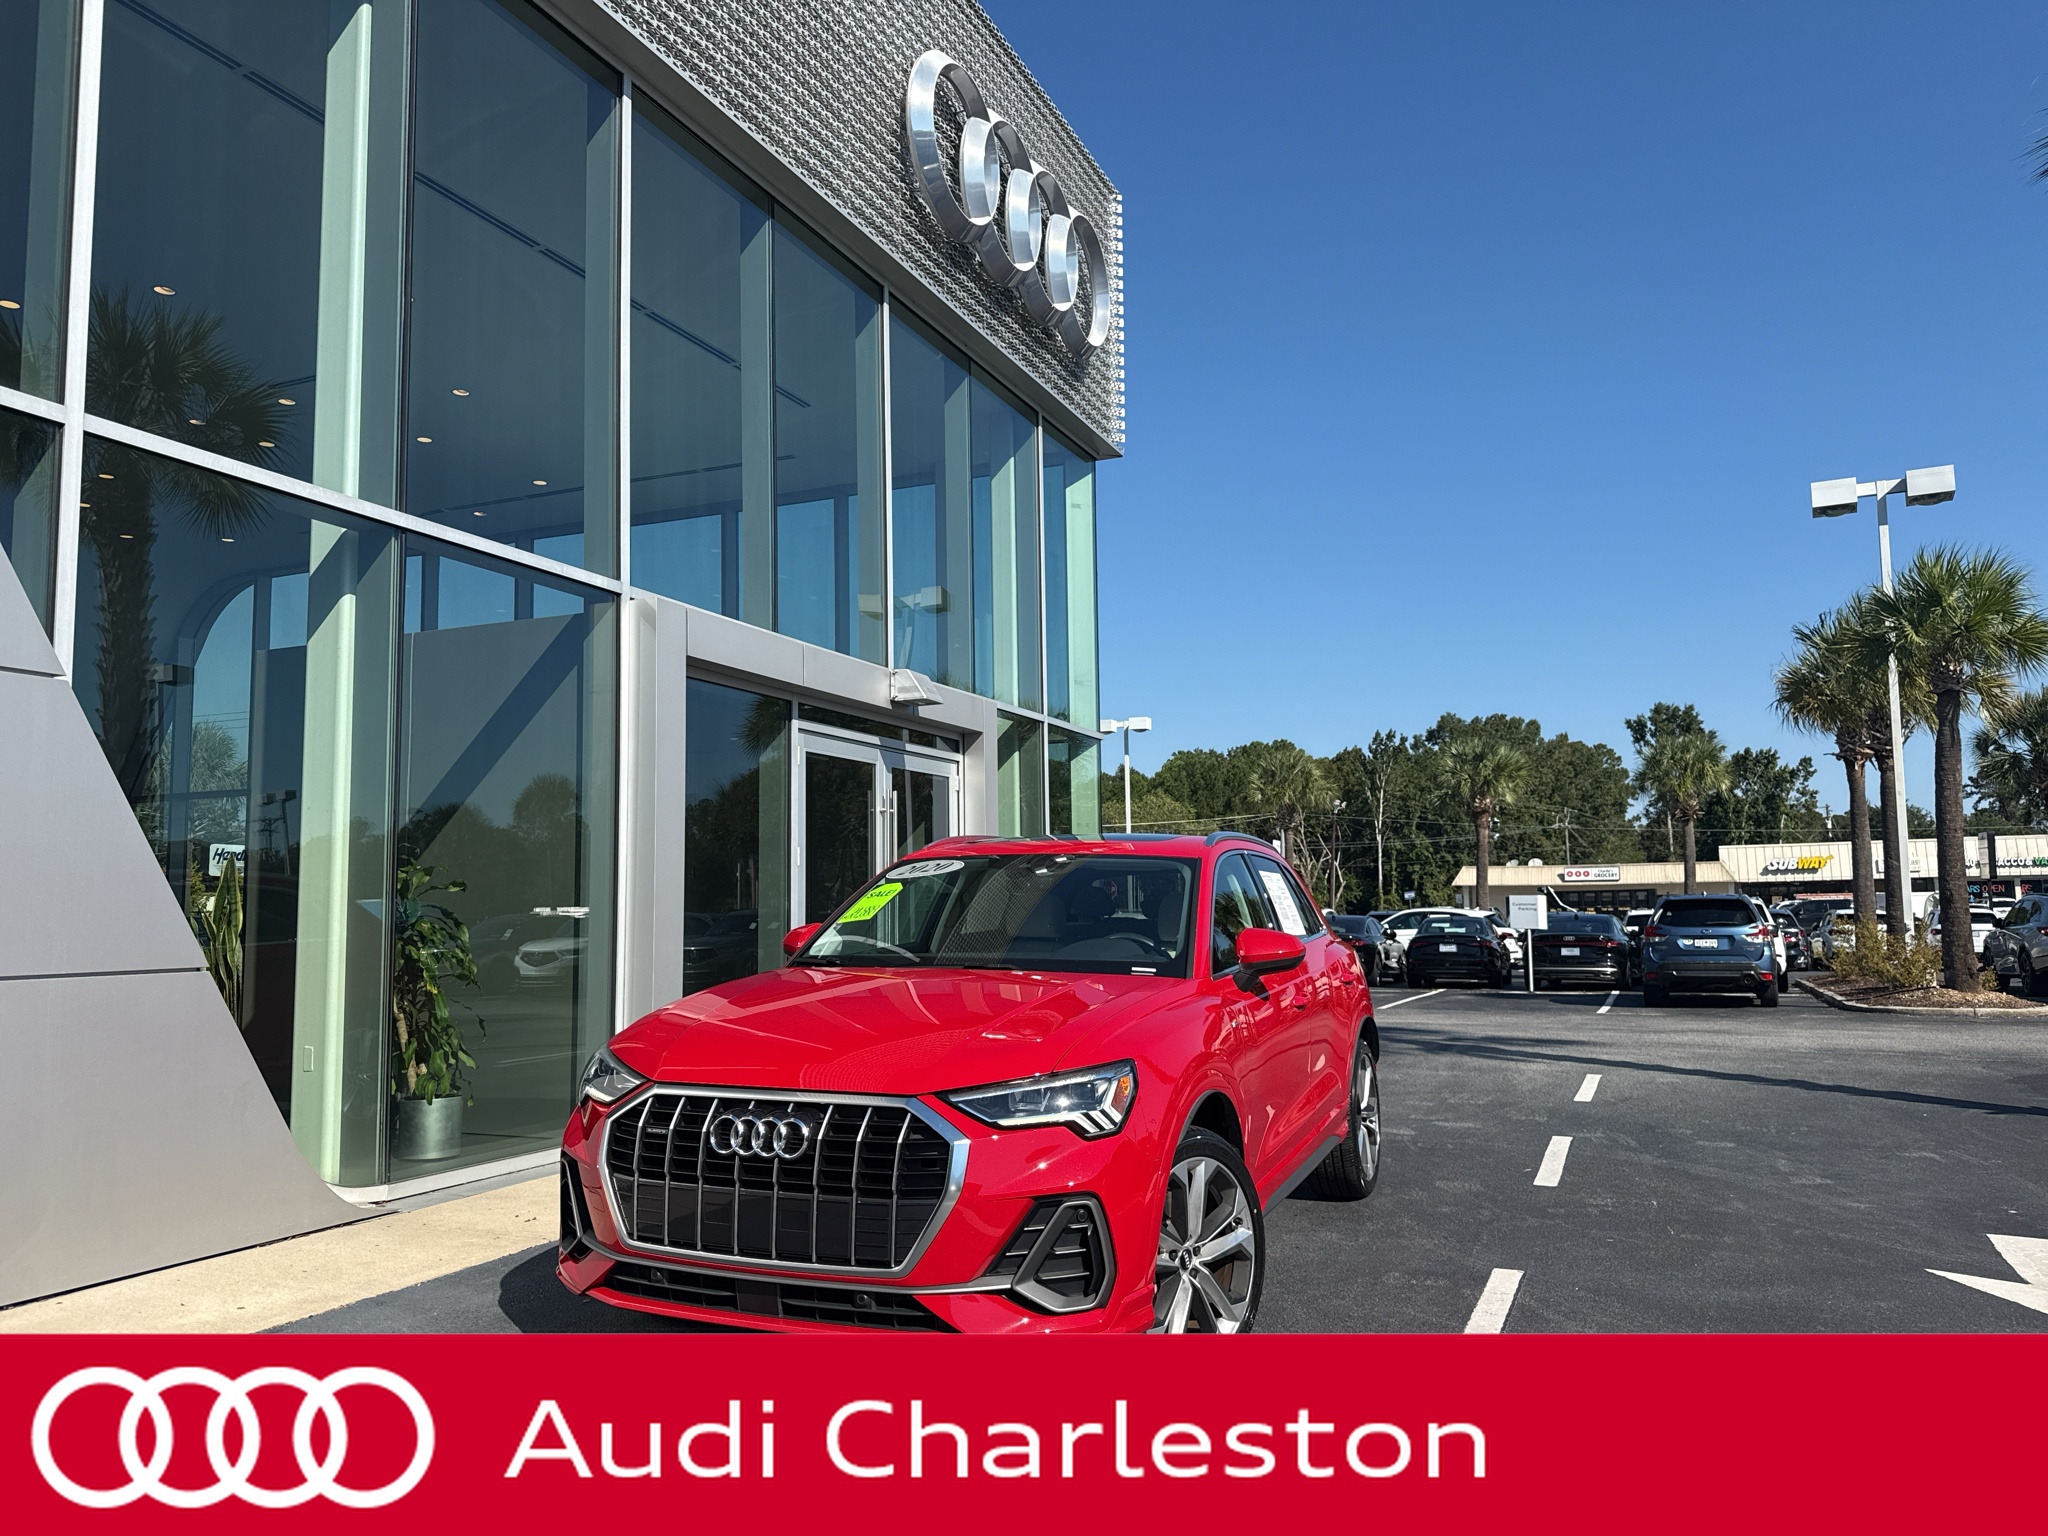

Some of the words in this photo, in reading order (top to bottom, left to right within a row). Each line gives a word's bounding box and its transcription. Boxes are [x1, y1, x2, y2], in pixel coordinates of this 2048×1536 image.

[895, 862, 955, 876] 2020
[1767, 855, 1834, 871] SUBWAY
[866, 889, 898, 899] SALE!
